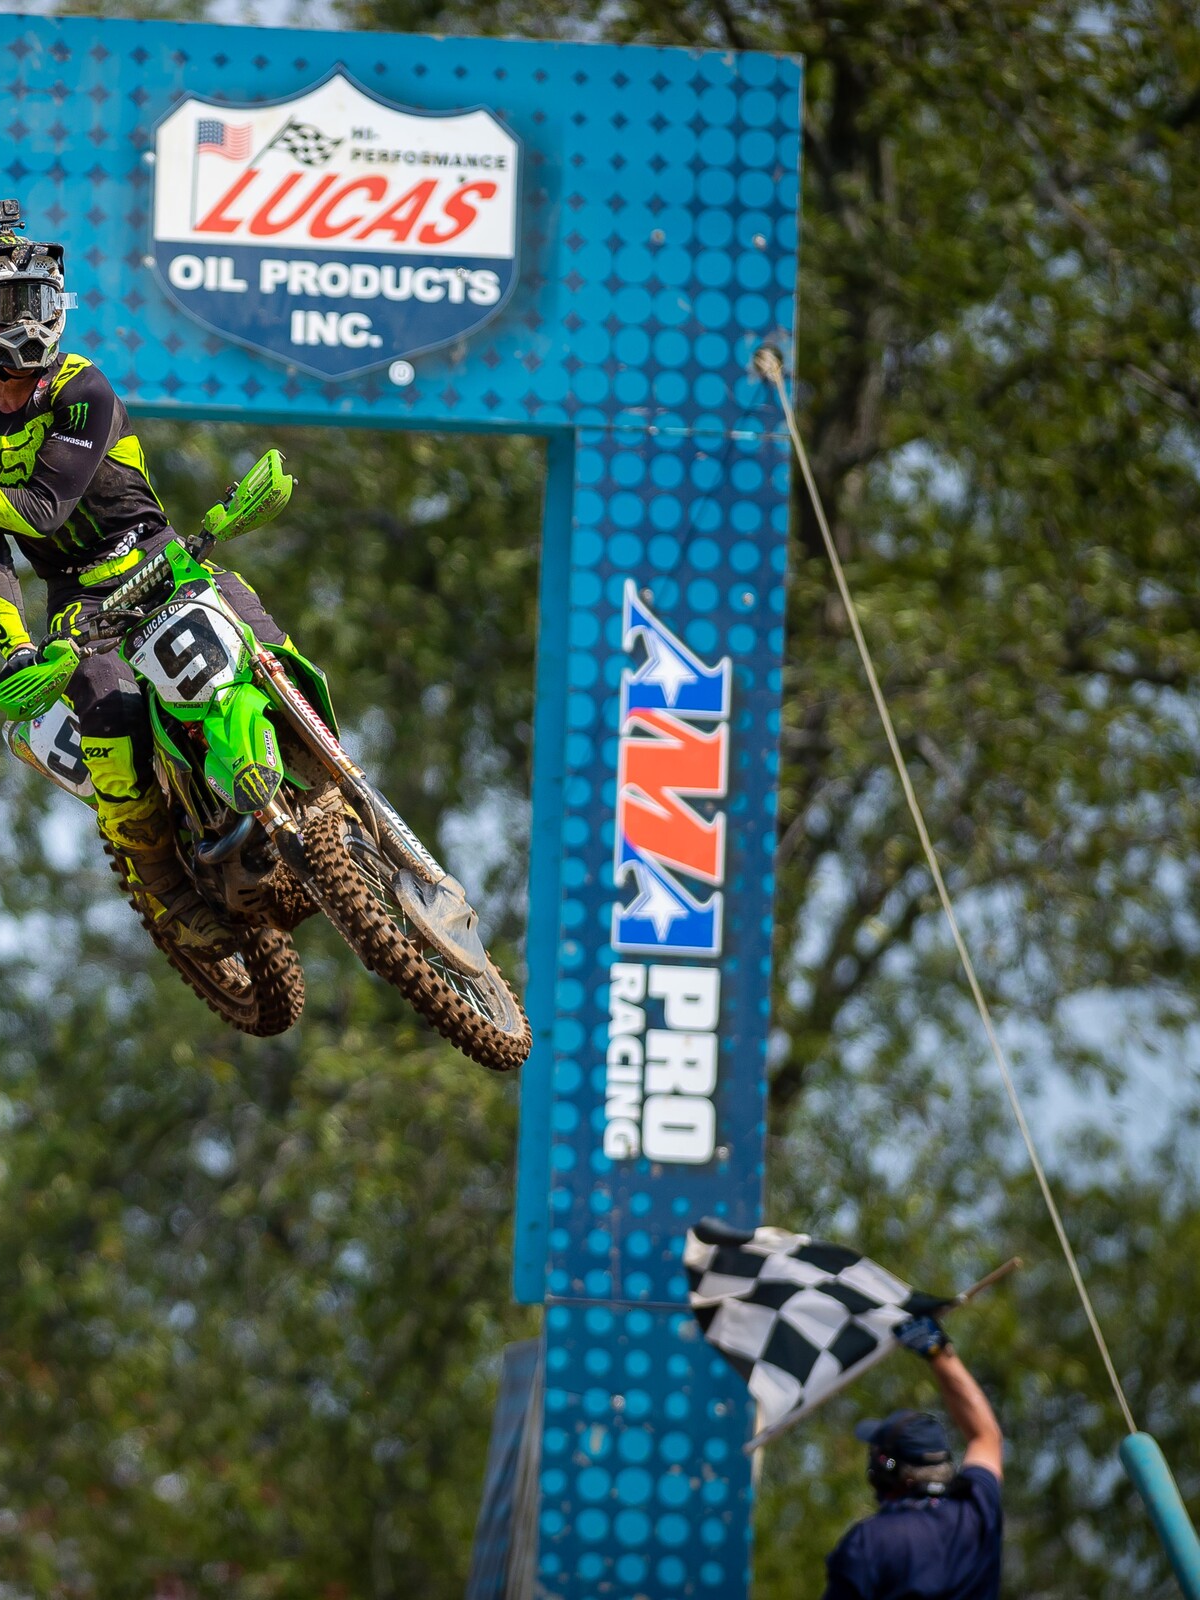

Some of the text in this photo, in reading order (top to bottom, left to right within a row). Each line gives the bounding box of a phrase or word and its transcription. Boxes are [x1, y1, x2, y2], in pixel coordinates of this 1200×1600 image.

[350, 147, 508, 171] PERFORMANCE
[192, 167, 498, 245] LUCAS
[168, 254, 502, 306] OIL PRODUCTS
[290, 309, 383, 348] INC.
[51, 431, 93, 449] Kawasaki
[102, 552, 167, 611] RENTHA
[112, 562, 171, 611] ENTHA
[142, 610, 168, 640] LUCAS
[154, 607, 229, 701] 9
[174, 701, 204, 709] Kawasaki
[84, 746, 114, 761] FOX
[612, 577, 732, 957] AMA
[603, 961, 646, 1162] RACING
[641, 963, 721, 1166] PRO
